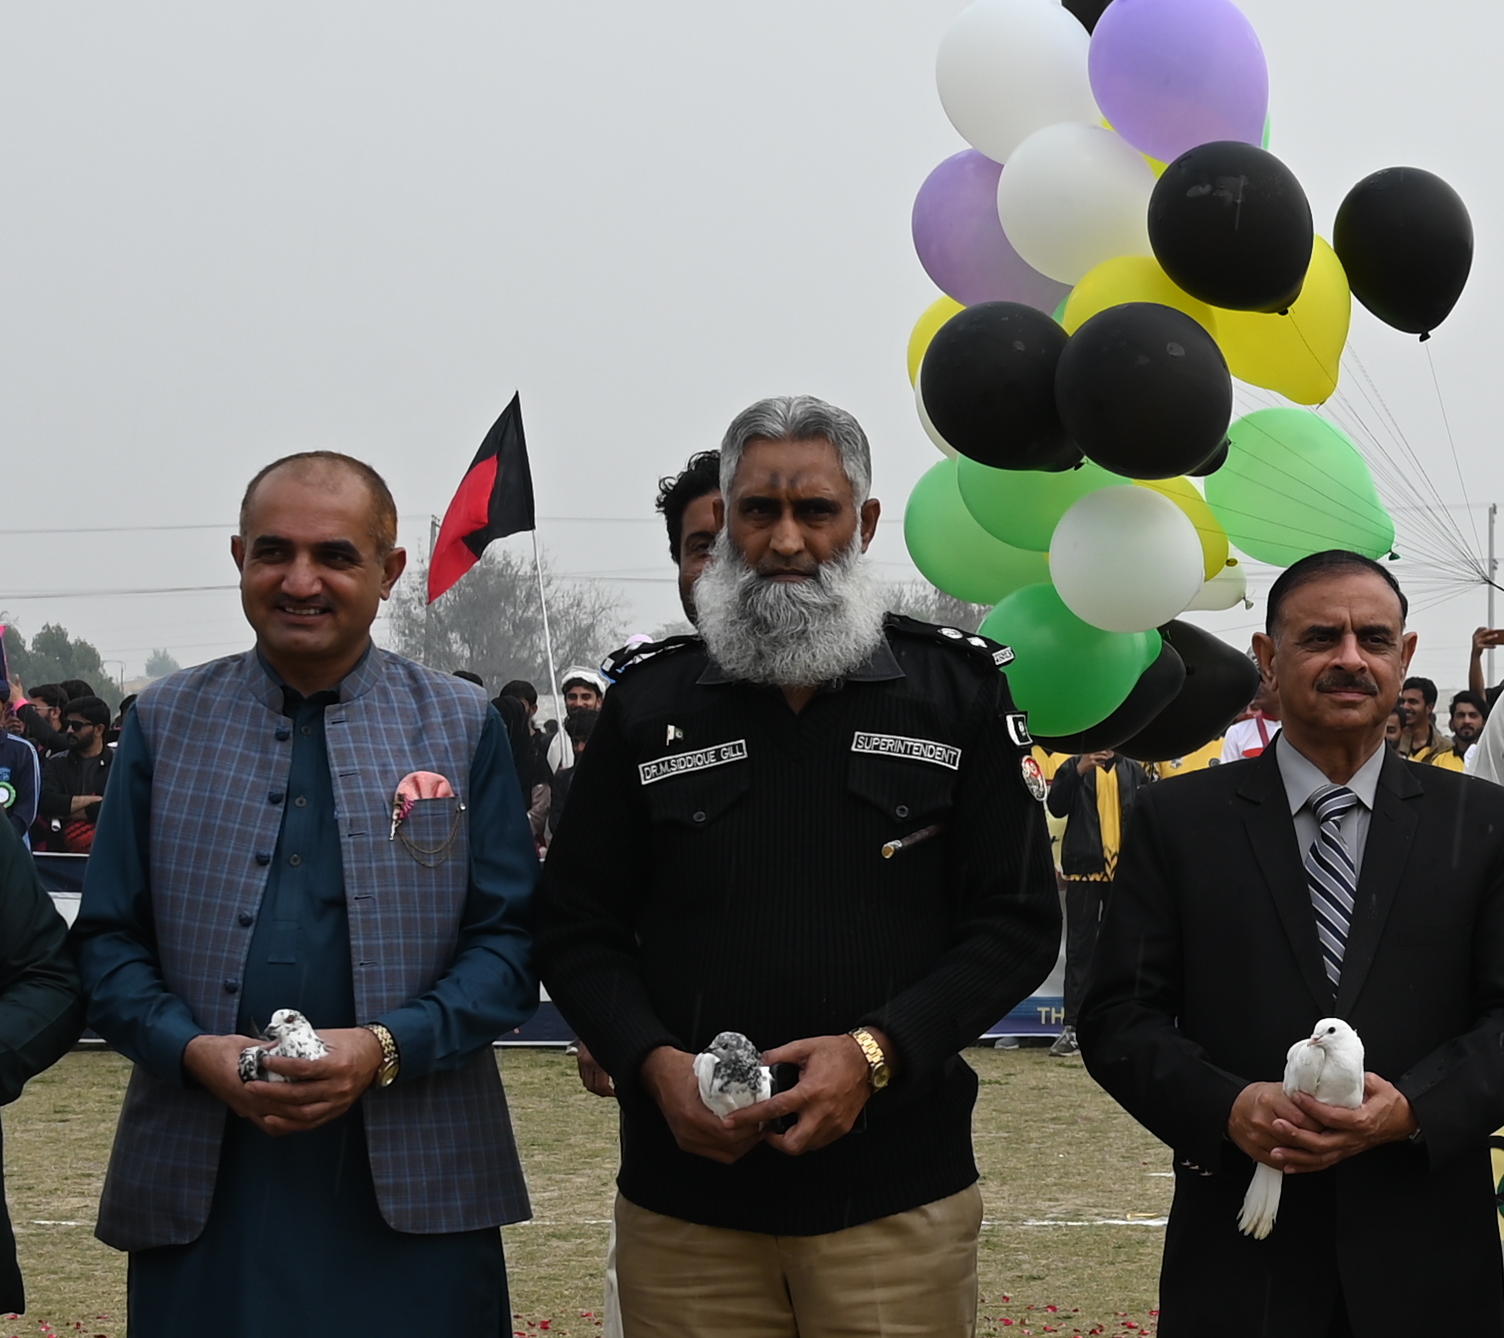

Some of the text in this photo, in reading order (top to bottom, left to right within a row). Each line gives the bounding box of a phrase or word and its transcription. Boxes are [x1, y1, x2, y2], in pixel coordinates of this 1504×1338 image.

[643, 743, 744, 779] DR.M.SIDDIQUE GILL
[856, 735, 957, 765] SUPERINTENDENT
